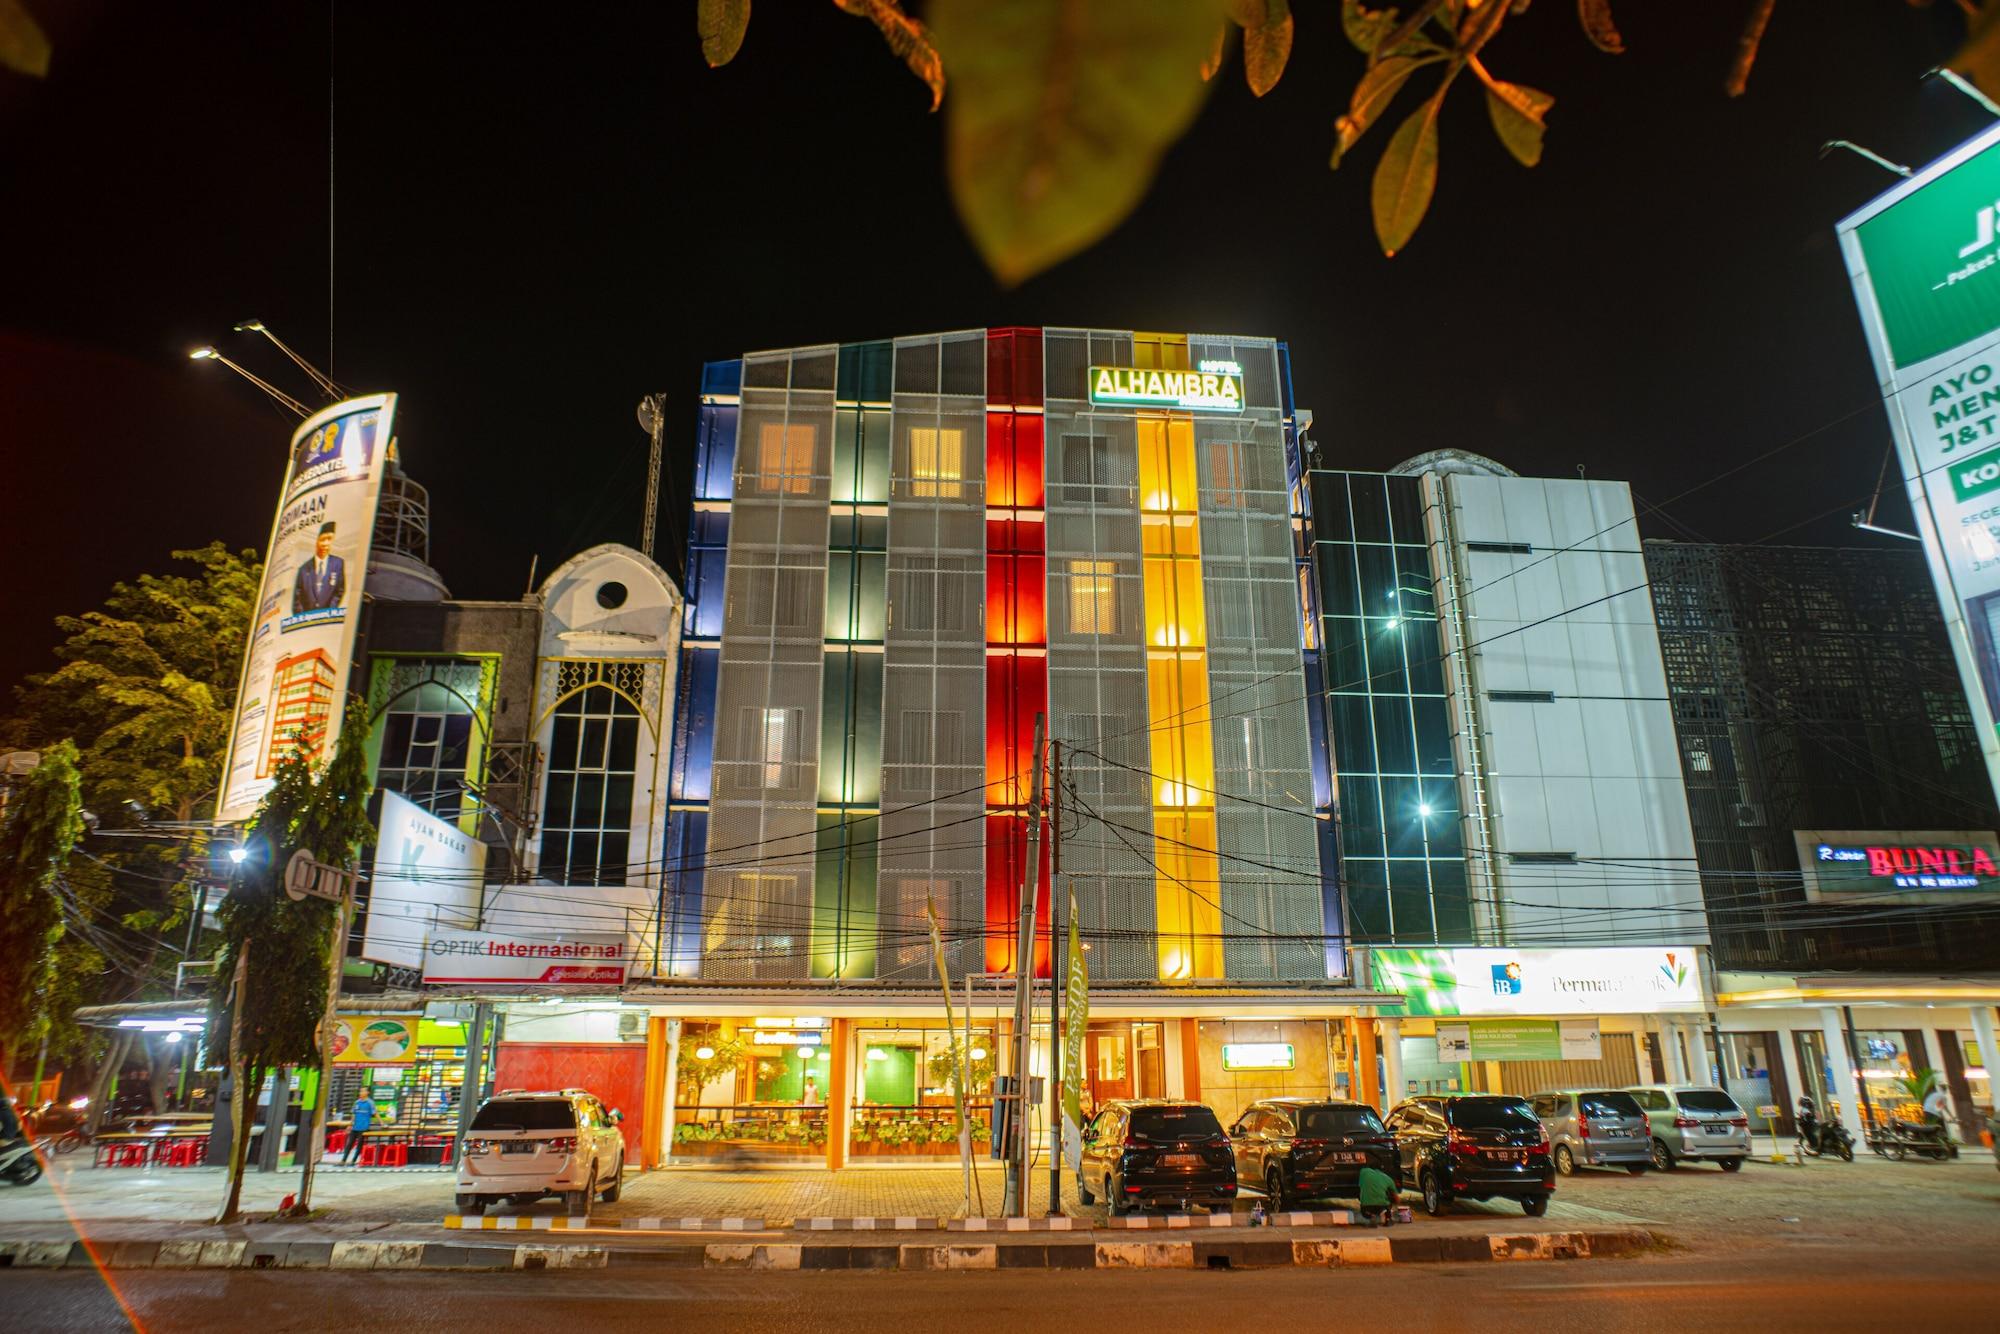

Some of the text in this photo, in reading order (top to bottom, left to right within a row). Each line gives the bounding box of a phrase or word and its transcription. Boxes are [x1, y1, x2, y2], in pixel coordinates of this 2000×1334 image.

[1095, 369, 1240, 400] ALHAMBRA
[1928, 364, 1992, 406] AYO
[1938, 414, 1996, 454] J&T
[1960, 460, 2000, 489] KO
[410, 818, 466, 854] AYAM BAKAR
[401, 837, 425, 886] K
[431, 940, 485, 956] OPTIK
[488, 941, 624, 958] Internasional
[1494, 979, 1511, 995] iB
